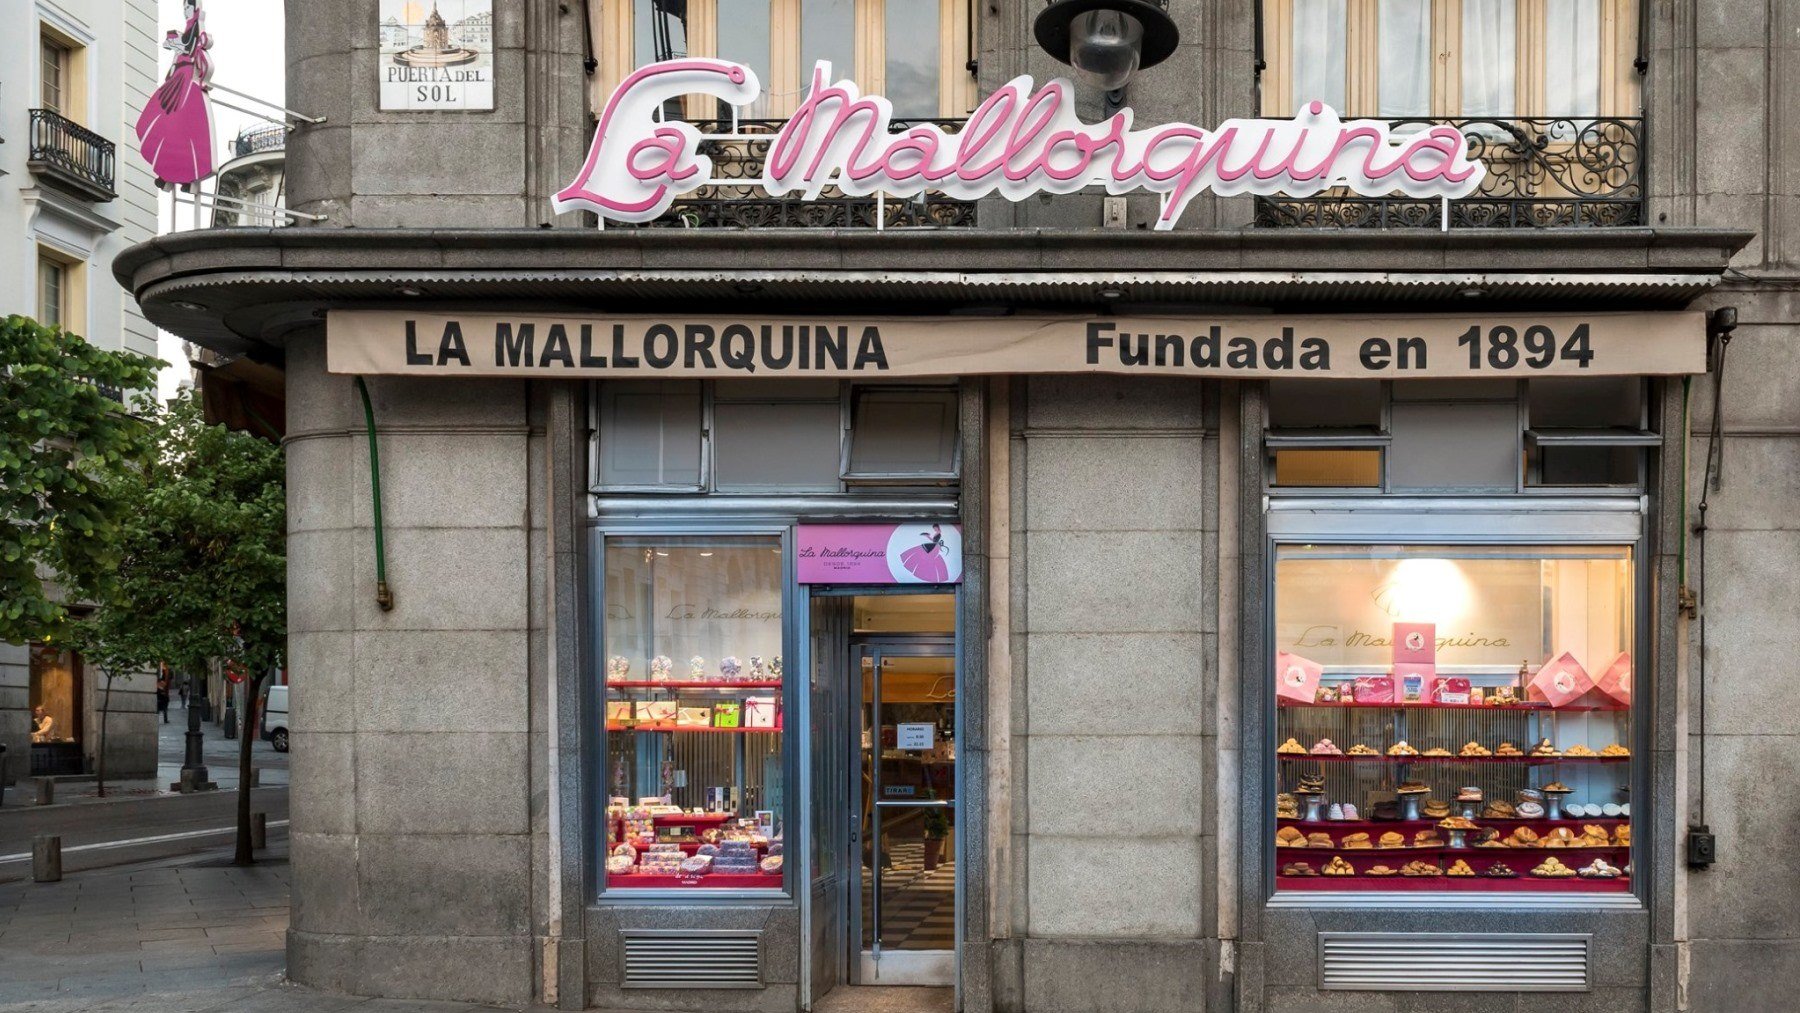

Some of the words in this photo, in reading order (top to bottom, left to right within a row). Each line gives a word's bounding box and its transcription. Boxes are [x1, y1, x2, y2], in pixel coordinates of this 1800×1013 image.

[388, 66, 452, 82] PUERTA
[455, 70, 485, 82] DEL
[417, 85, 456, 102] SOL
[551, 57, 760, 222] La
[763, 60, 1487, 231] Mallorquina
[406, 320, 470, 367] LA
[496, 322, 888, 373] MALLORQUINA
[1087, 322, 1329, 370] Fundada
[1360, 337, 1426, 370] en
[1459, 324, 1593, 369] 1894
[799, 546, 816, 558] La
[820, 547, 885, 560] Mallorquina
[664, 603, 696, 620] La
[1293, 626, 1338, 648] La
